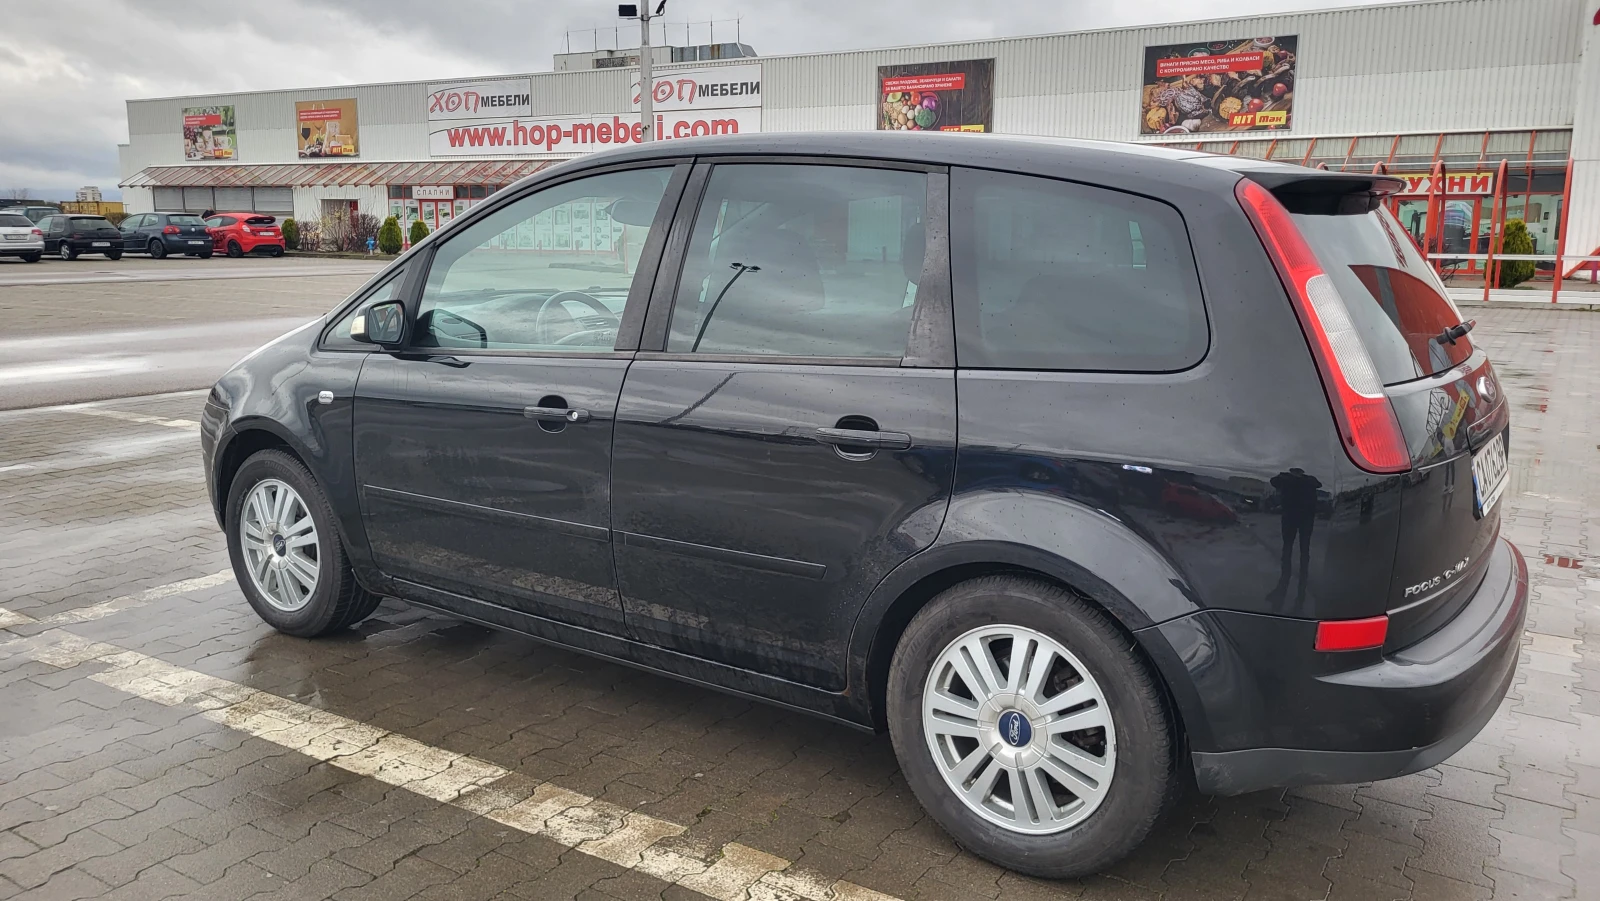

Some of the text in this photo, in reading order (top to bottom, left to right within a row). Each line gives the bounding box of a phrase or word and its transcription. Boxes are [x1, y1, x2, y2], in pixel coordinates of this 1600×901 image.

[1164, 66, 1203, 74] КОНТРОЛИРАНО
[698, 81, 760, 97] МЕБЕЛИ
[429, 91, 530, 113] ХОП МЕБЕЛИ
[1233, 115, 1254, 124] HIT
[446, 114, 739, 152] www.hop-mebei.com
[1402, 175, 1490, 193] УХНИ
[1404, 575, 1441, 598] FOCUS
